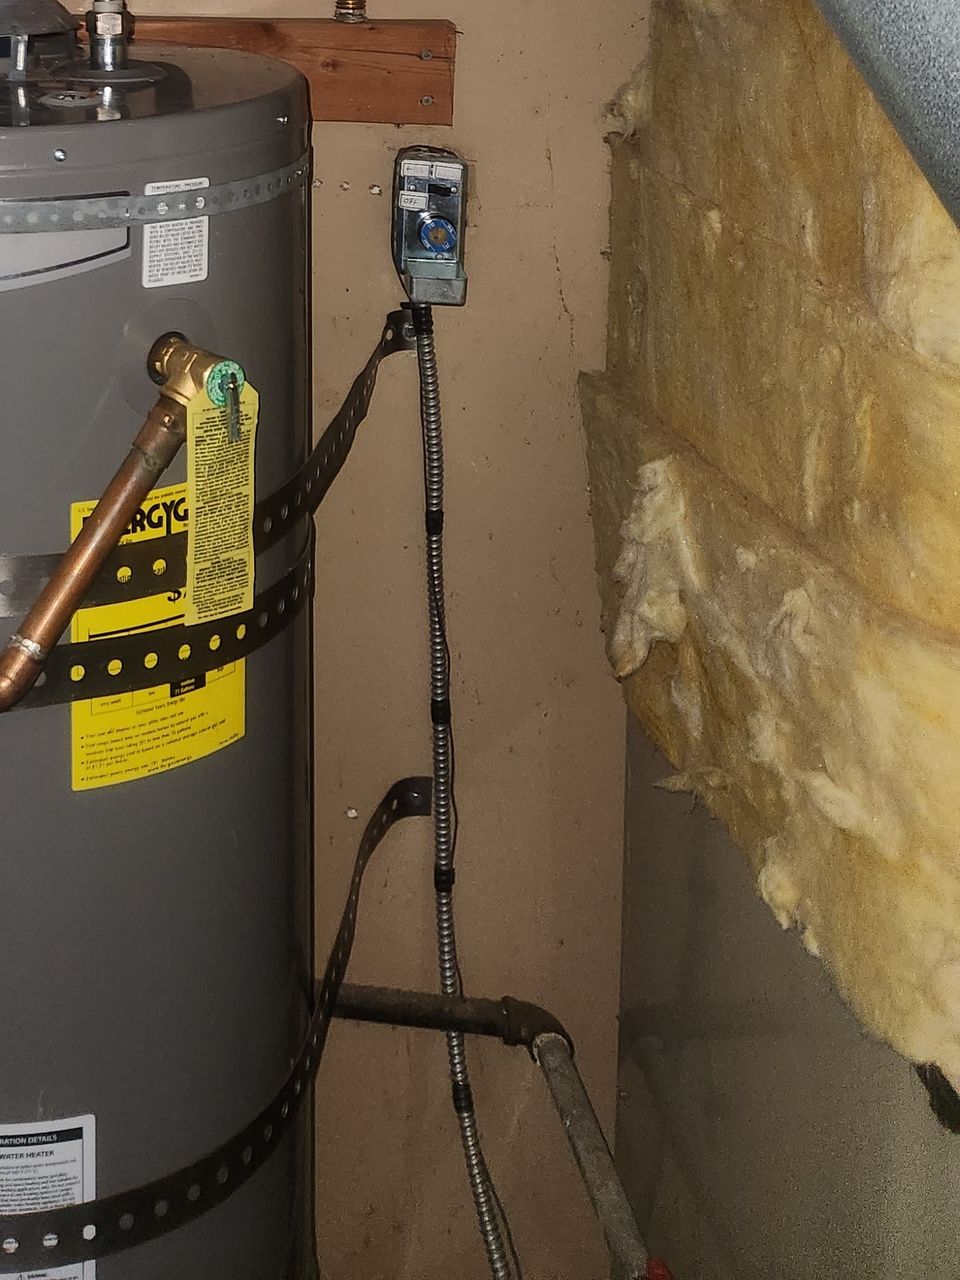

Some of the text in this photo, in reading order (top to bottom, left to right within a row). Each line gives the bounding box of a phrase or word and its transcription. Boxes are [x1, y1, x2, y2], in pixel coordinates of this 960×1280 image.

[403, 198, 419, 206] OFF
[27, 1133, 58, 1144] DETAILS
[26, 1149, 55, 1159] HEATER
